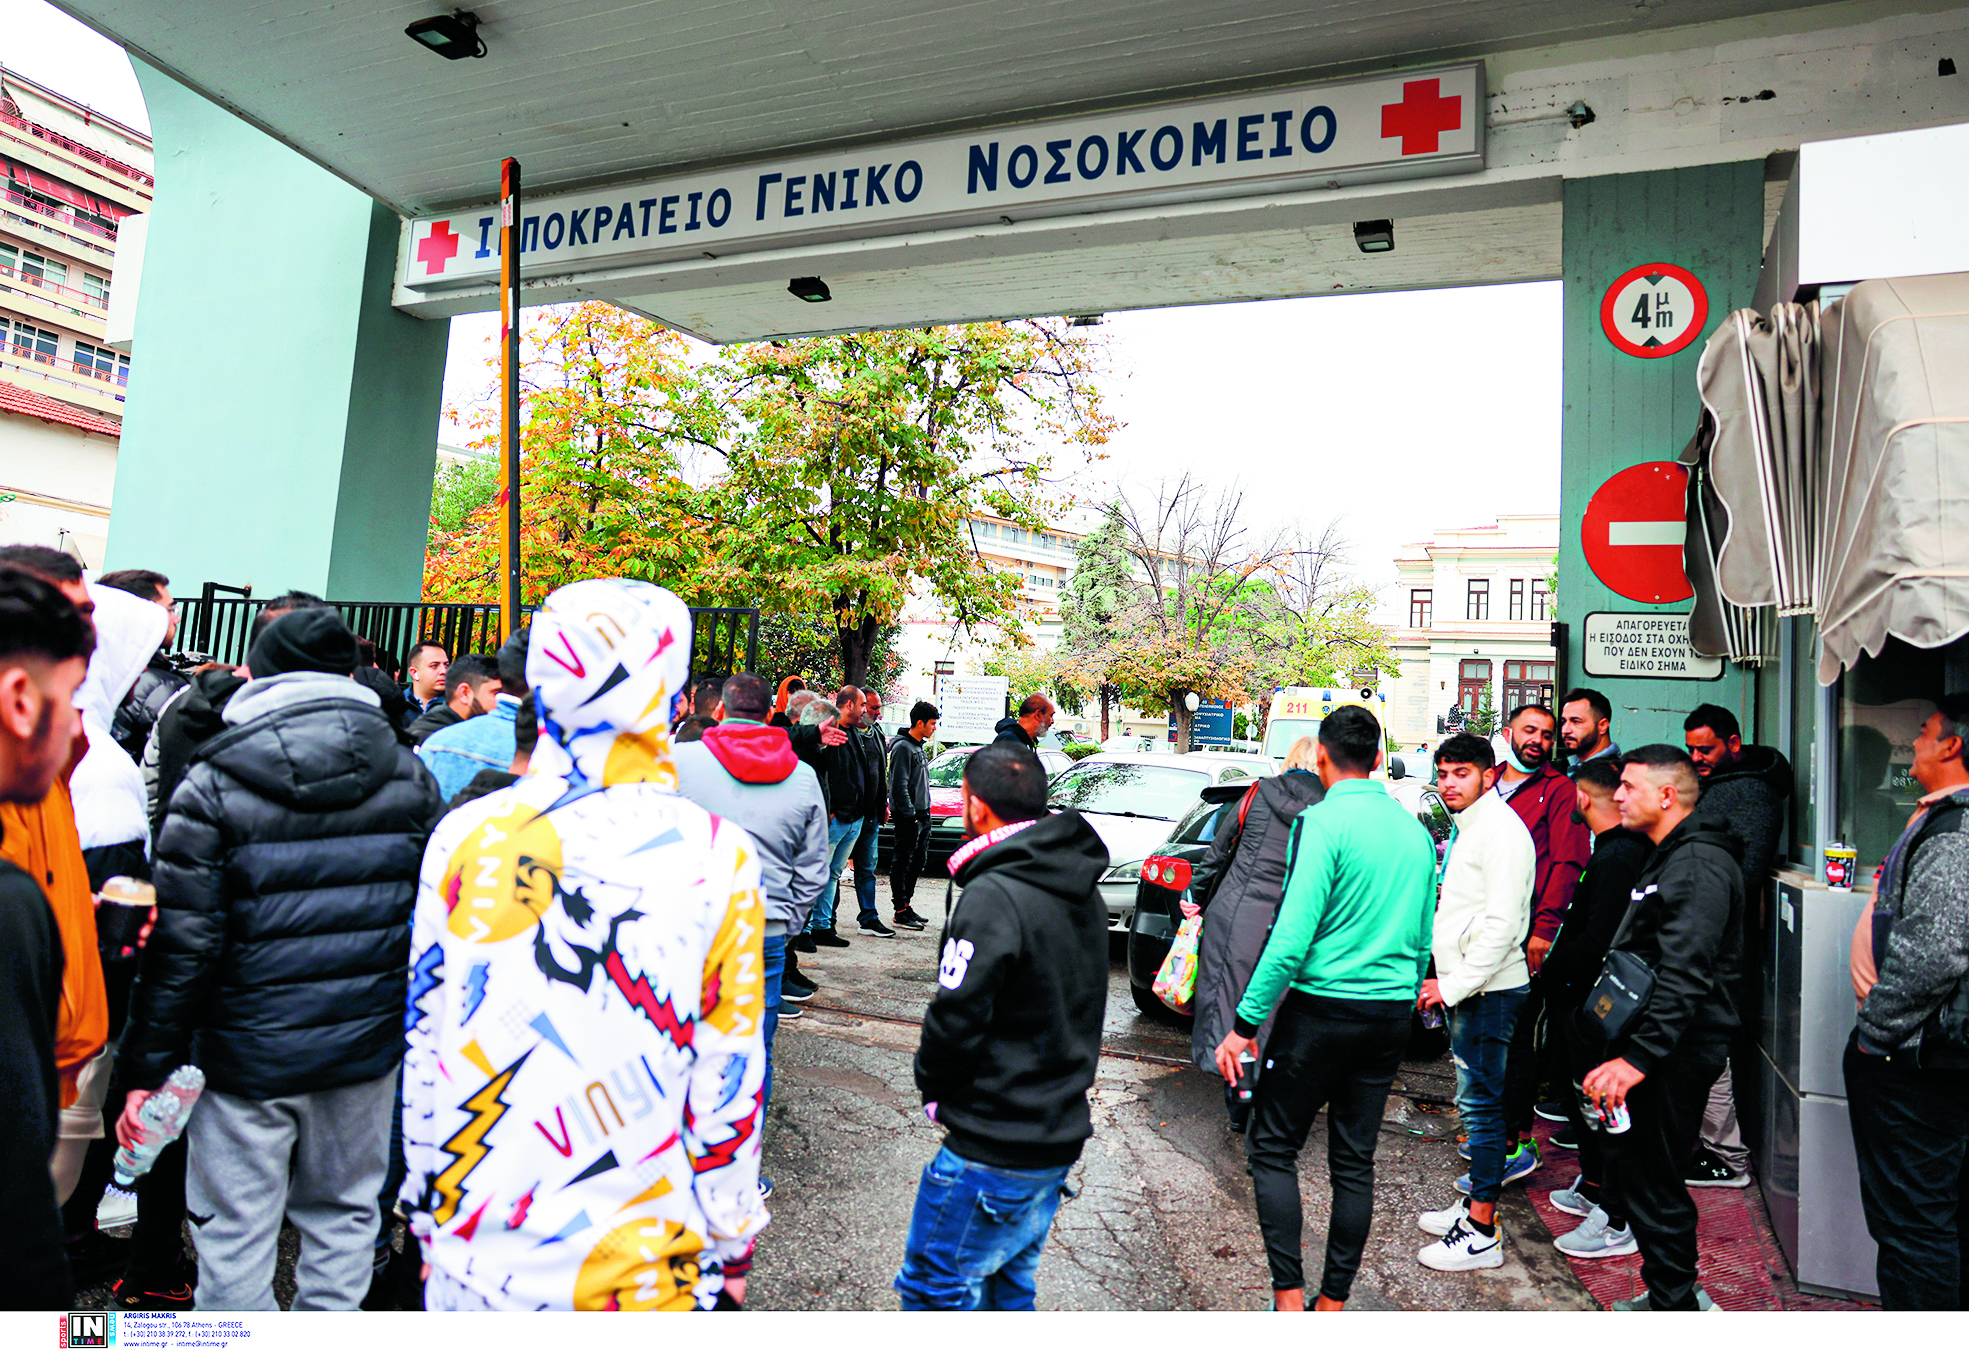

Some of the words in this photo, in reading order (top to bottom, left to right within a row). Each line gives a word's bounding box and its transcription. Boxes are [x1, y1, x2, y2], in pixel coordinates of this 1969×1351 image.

[474, 188, 732, 259] ΙΠΟΚΡΑΤΕΙΟ
[755, 160, 924, 221] ΓΕΝΙΚΟ
[966, 106, 1338, 194] ΝΟΣΟΚΟΜΕΙΟ
[1631, 293, 1652, 328] 4
[1656, 310, 1673, 328] m
[1616, 620, 1687, 631] ΑΠΑΓΟΡΕΥΕΤΑ
[1589, 633, 1596, 643] Η
[1599, 633, 1643, 644] ΕΙΣΟΔΟΣ
[1646, 634, 1665, 644] ΣΤΑ
[1668, 634, 1689, 645] ΟΧΗ
[1603, 646, 1625, 656] ΠΟΥ
[1627, 647, 1648, 657] ΔΕΝ
[1651, 647, 1686, 658] ΕΧΟΥΝ
[1619, 660, 1655, 671] ΕΙΔΙΚΟ
[1657, 661, 1687, 672] ΣΗΜΑ
[1286, 702, 1308, 714] 211
